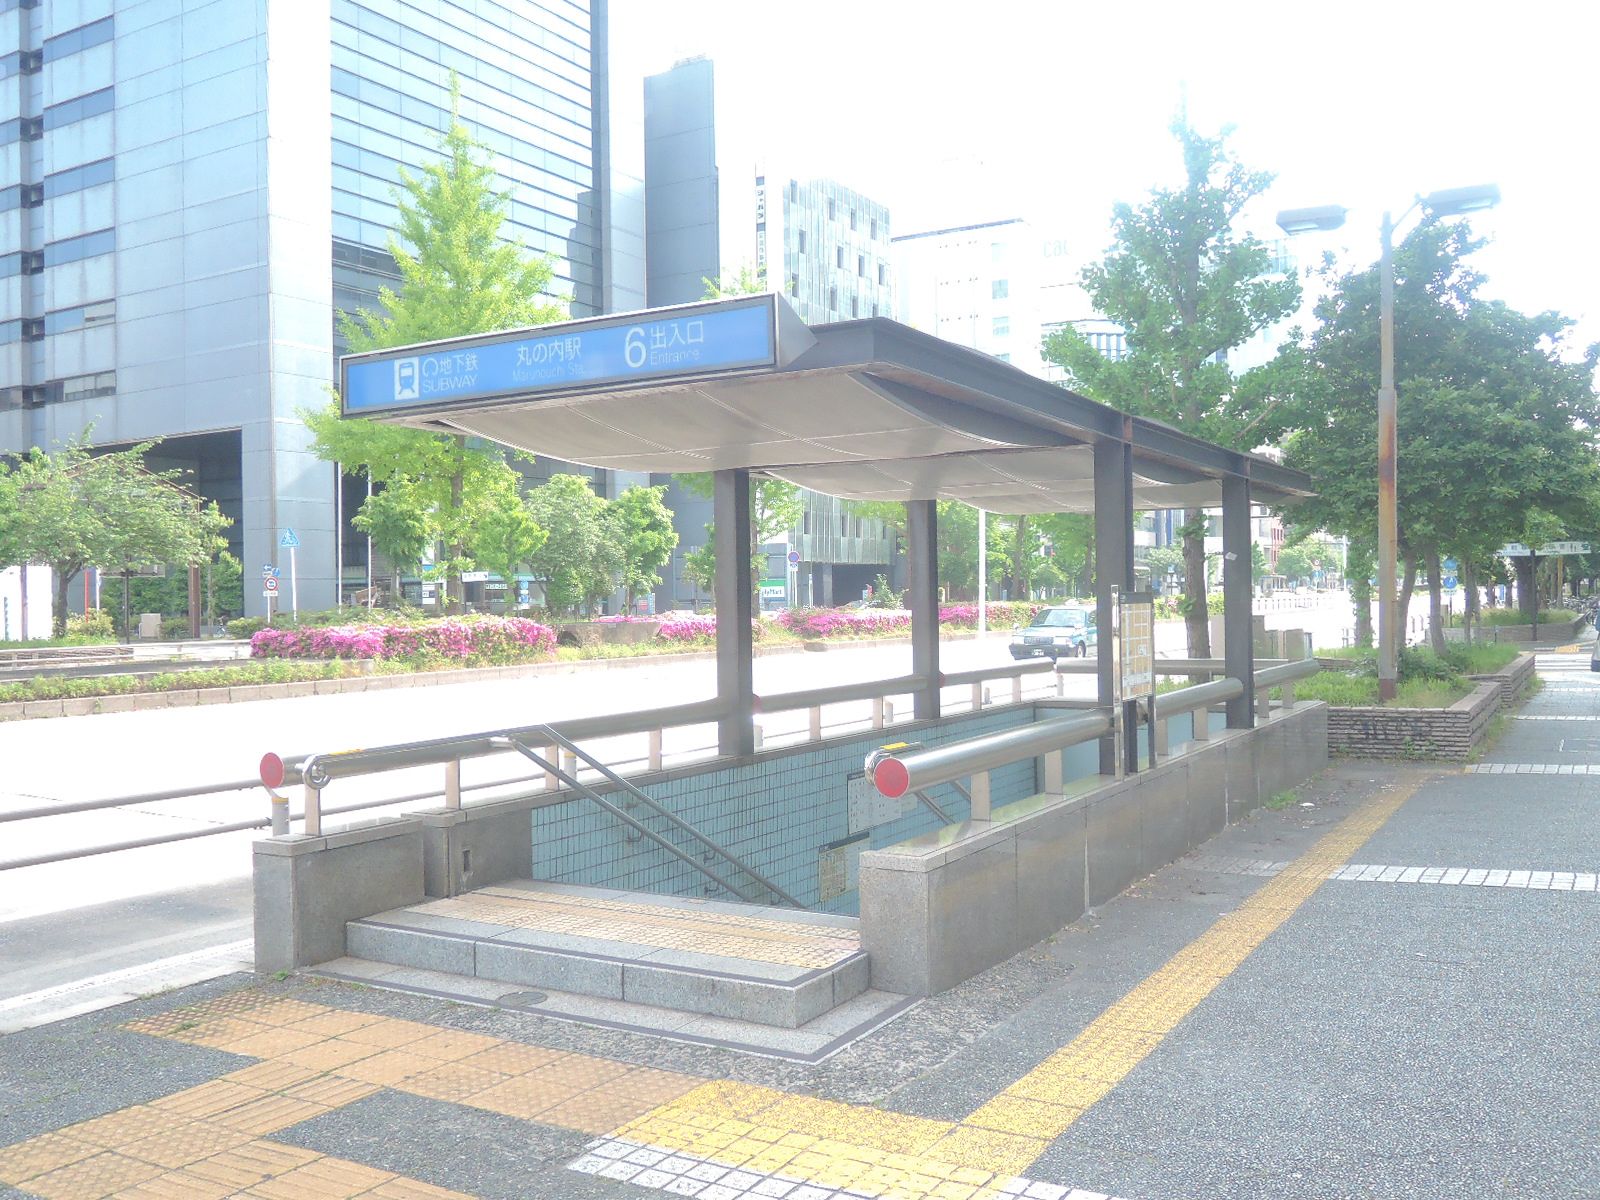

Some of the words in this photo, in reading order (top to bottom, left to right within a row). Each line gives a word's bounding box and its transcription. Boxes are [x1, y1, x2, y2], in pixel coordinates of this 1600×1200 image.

[516, 336, 582, 367] 丸の内駅
[624, 327, 647, 368] 6
[650, 320, 704, 350] 出入口
[439, 353, 479, 375] 地下鉄
[650, 347, 701, 366] Entrance
[422, 374, 478, 394] SUBWAY
